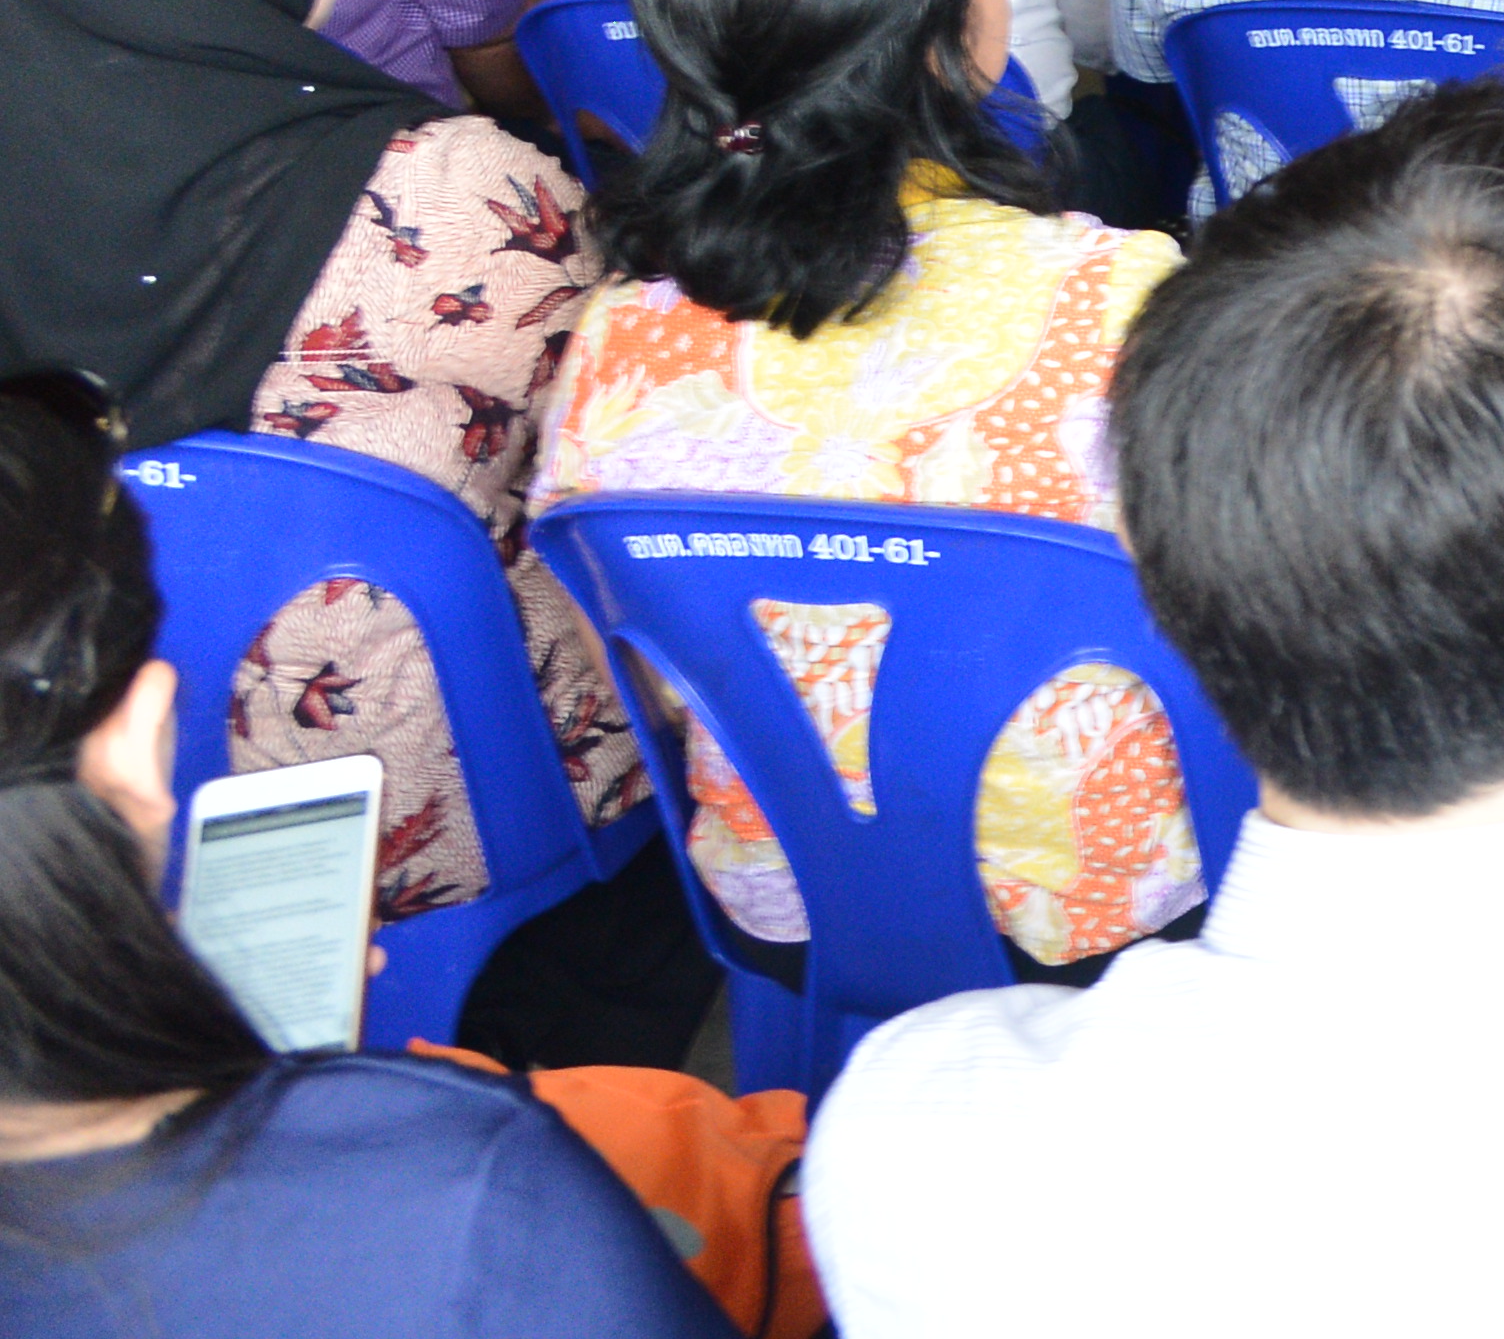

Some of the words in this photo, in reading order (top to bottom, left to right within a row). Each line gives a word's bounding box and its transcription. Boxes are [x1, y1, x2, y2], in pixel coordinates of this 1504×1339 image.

[1387, 28, 1486, 56] 401-61-
[623, 533, 803, 559] อบต.คลองหก
[807, 533, 941, 566] 401-61-
